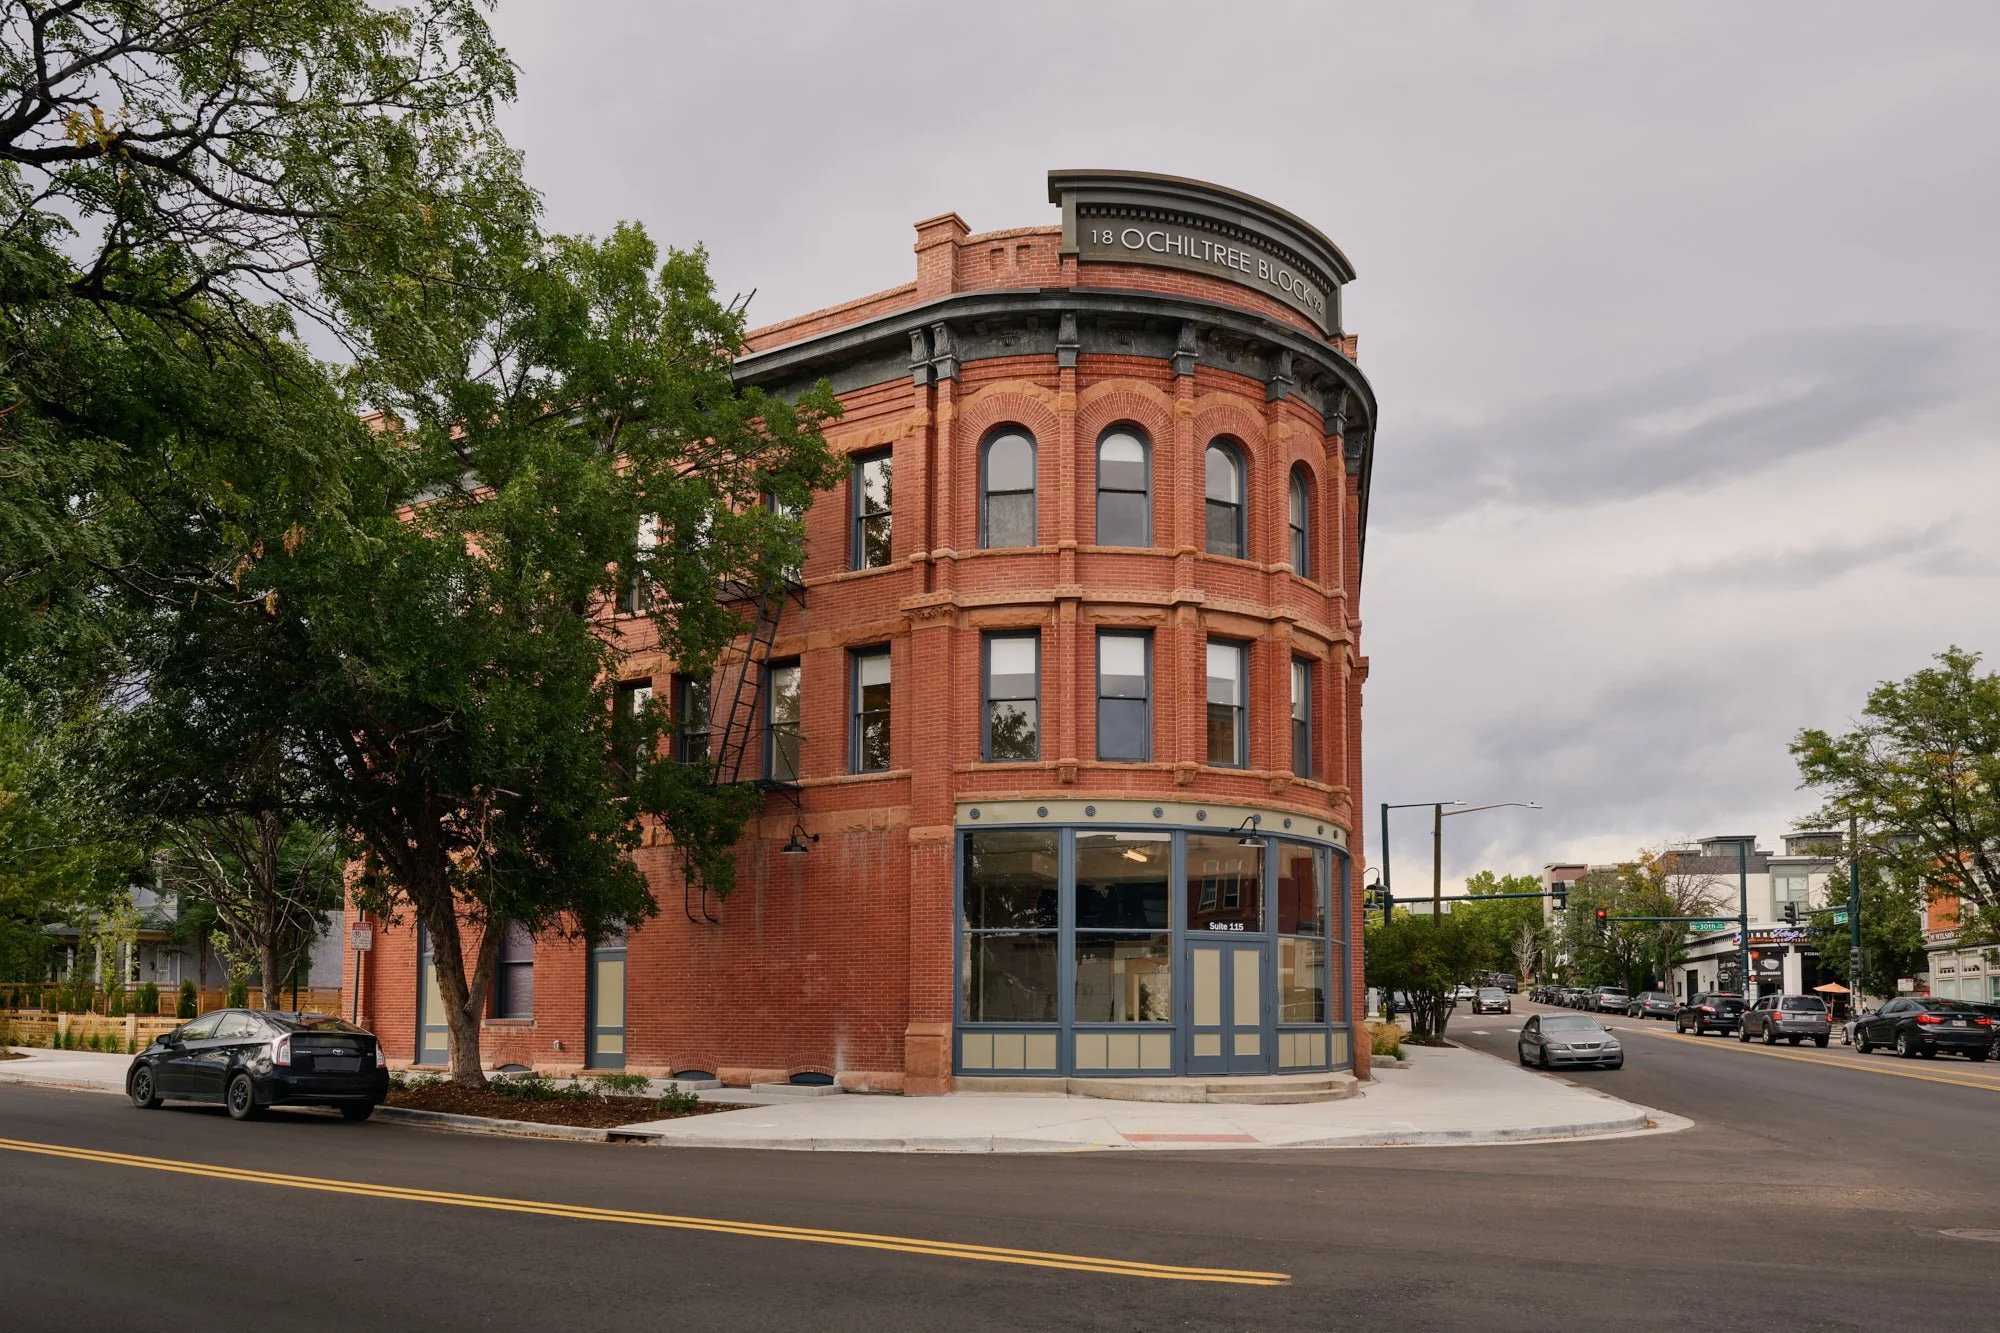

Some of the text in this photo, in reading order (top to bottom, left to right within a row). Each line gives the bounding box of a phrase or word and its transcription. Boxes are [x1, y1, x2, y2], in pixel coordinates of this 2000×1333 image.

[1092, 228, 1323, 314] 18 OCHILTREE BLOCK 92
[1209, 922, 1244, 931] Suite 115
